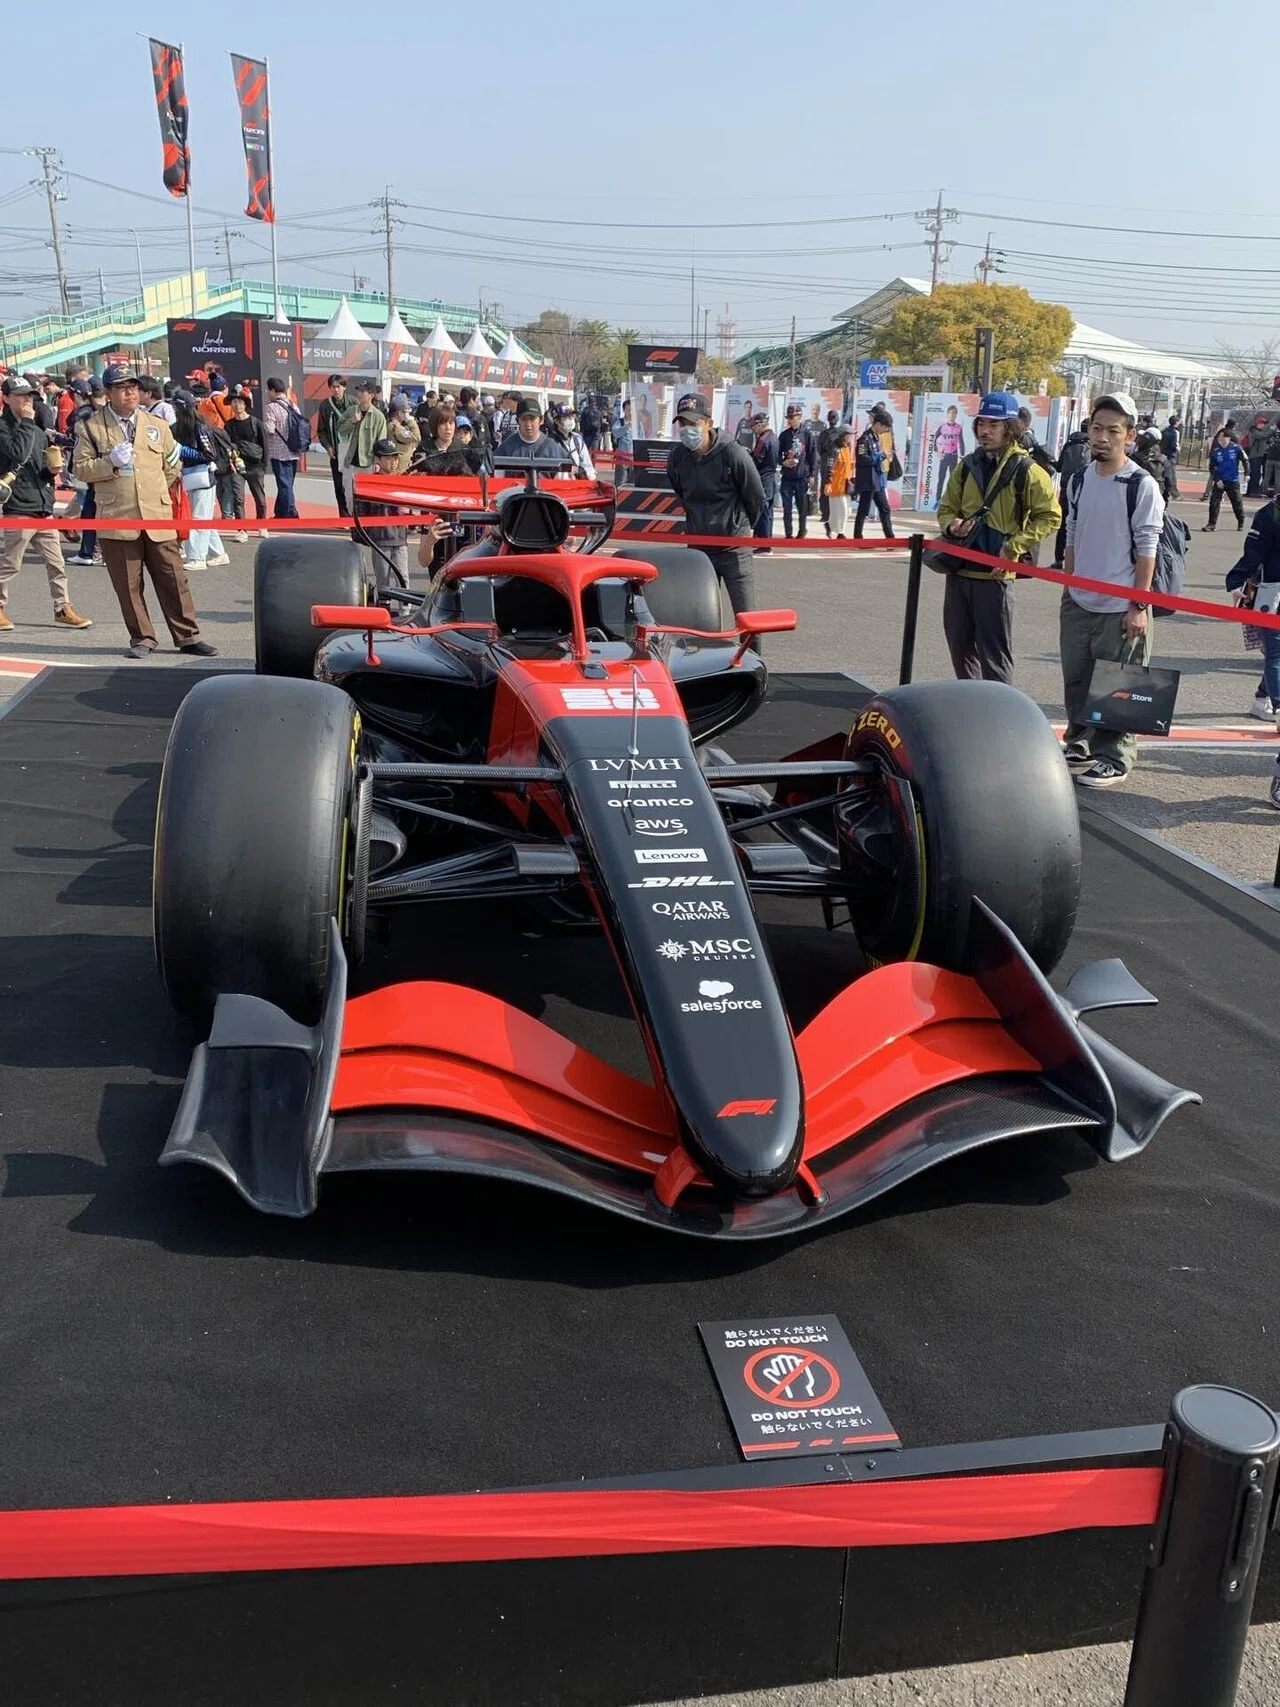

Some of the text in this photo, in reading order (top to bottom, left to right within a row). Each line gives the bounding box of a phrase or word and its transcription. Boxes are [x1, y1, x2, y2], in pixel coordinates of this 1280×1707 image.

[313, 347, 342, 358] Store
[923, 434, 935, 506] Franco Colapinto
[1131, 693, 1153, 702] Store
[857, 711, 902, 749] ZERO
[588, 758, 684, 771] LVMH
[607, 798, 694, 807] aramco
[635, 818, 685, 830] aws
[641, 851, 700, 860] Lenovo
[640, 875, 721, 888] DHL
[652, 900, 728, 916] QATAR
[673, 911, 731, 921] AIRWAYS
[688, 938, 753, 955] MSC
[681, 999, 762, 1013] salesforce
[724, 1325, 827, 1339] 触らないでください
[725, 1334, 829, 1348] DO NOT TOUCH
[751, 1406, 862, 1422] DO NOT TOUCH
[761, 1418, 873, 1435] 触らないでください
